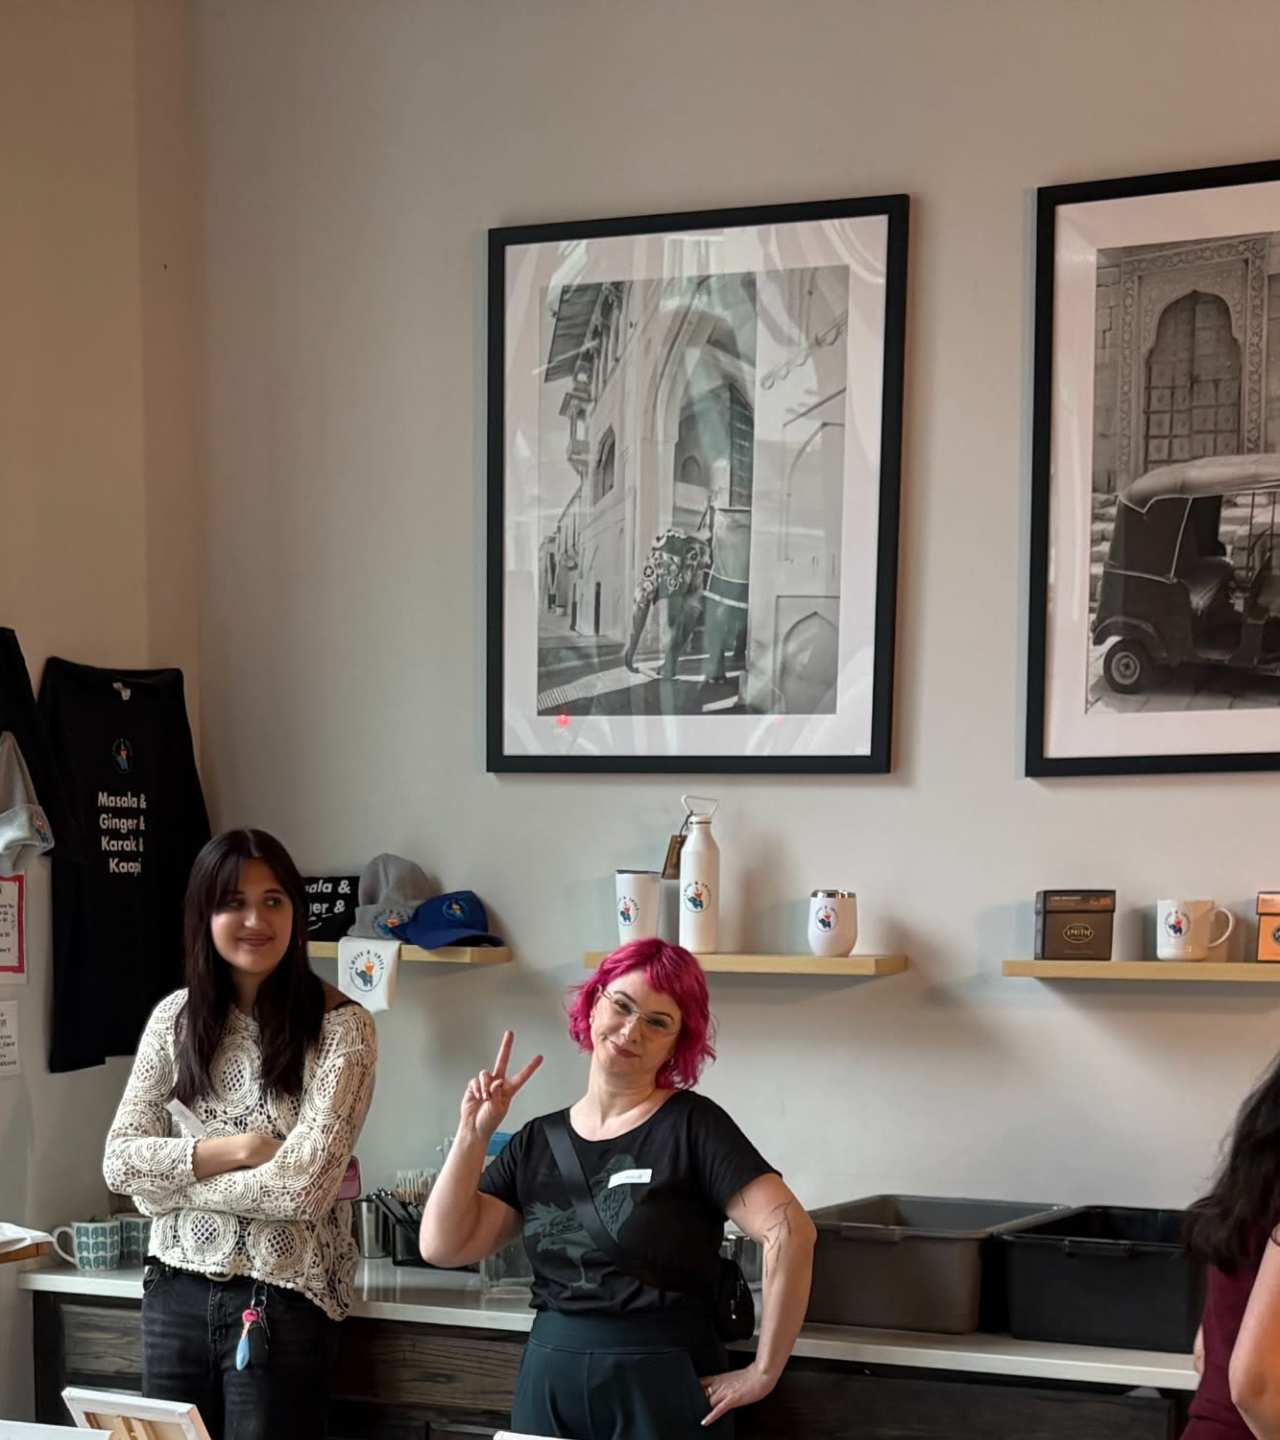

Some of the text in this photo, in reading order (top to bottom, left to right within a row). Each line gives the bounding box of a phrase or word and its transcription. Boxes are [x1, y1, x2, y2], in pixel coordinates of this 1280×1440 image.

[97, 791, 147, 809] Masala &
[99, 813, 138, 834] Ginger
[101, 835, 137, 852] Karak
[305, 879, 351, 894] ala &
[334, 899, 345, 914] &
